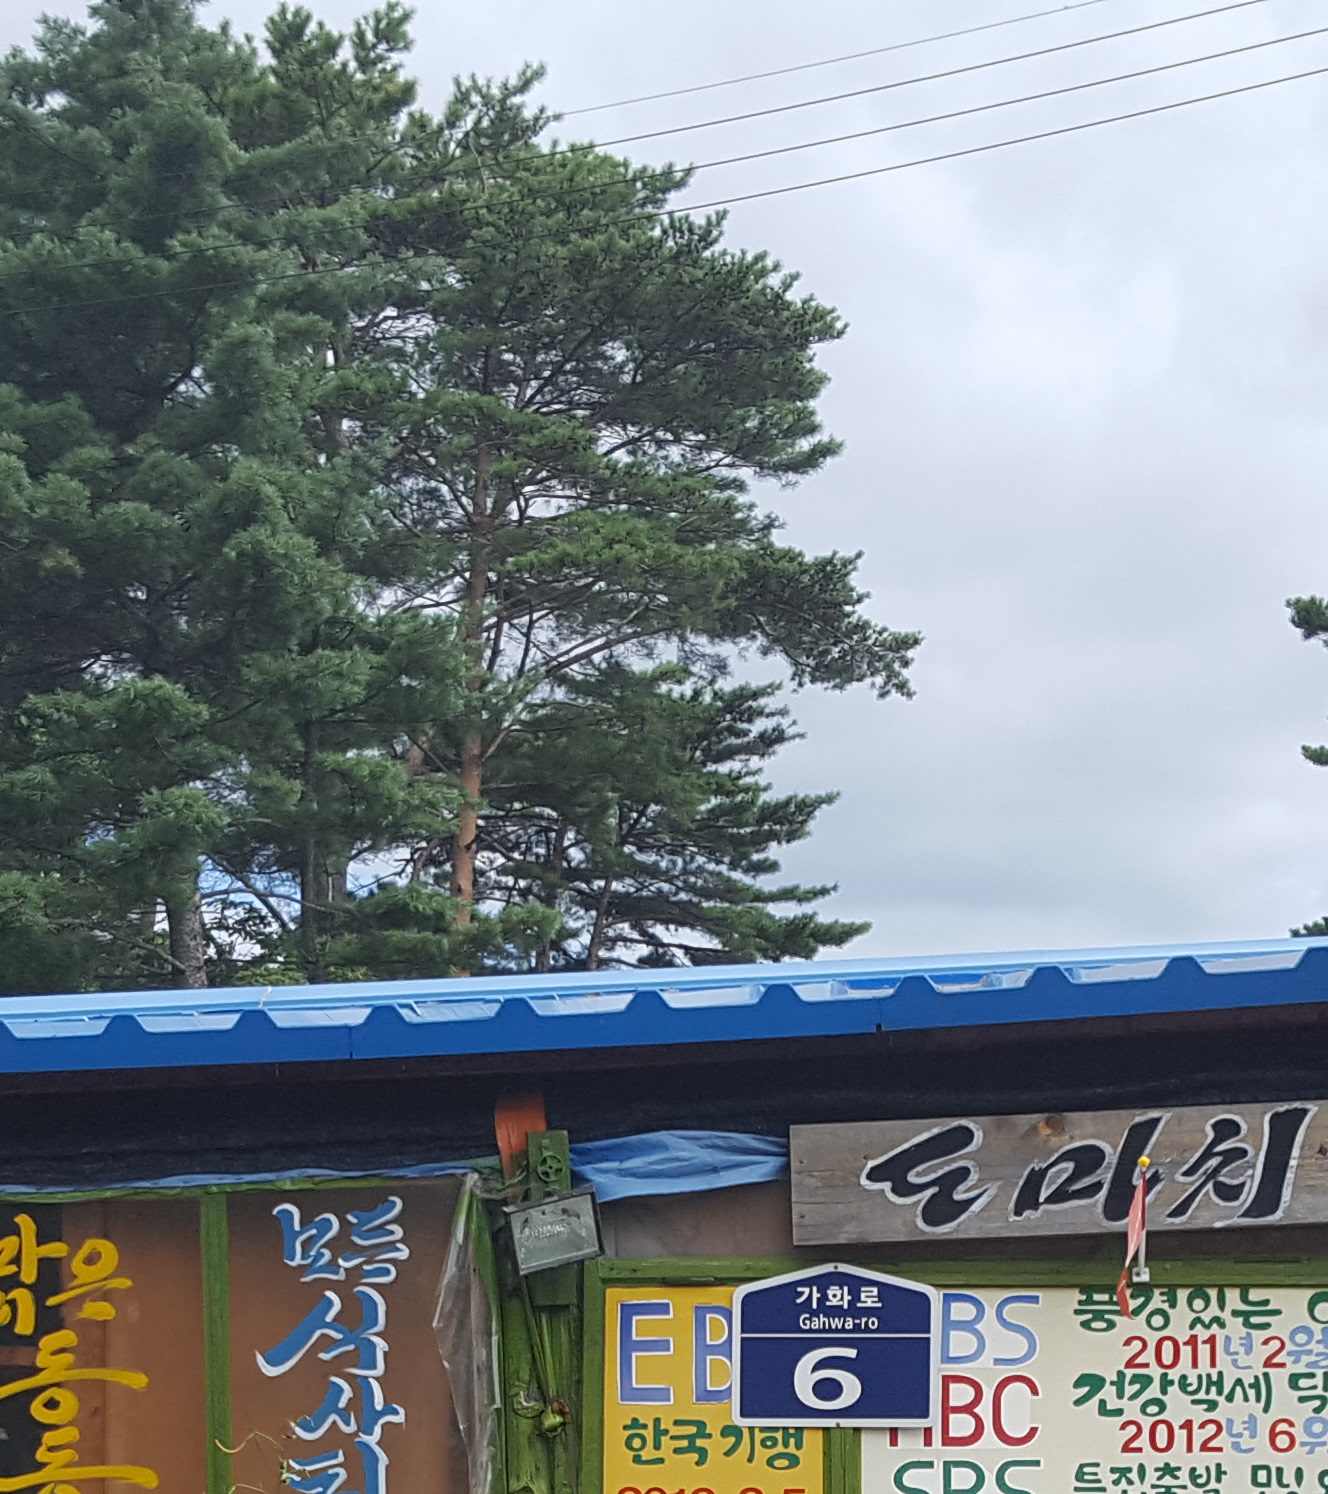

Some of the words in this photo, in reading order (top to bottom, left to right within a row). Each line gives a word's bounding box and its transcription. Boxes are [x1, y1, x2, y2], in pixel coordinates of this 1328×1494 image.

[795, 1285, 883, 1309] 가화로
[798, 1314, 879, 1332] Gahwa-ro
[940, 1293, 1042, 1367] BS
[1073, 1286, 1283, 1332] 풍경있는
[617, 1300, 732, 1404] EB
[793, 1347, 862, 1411] 6
[1072, 1370, 1273, 1417] 건강백세
[623, 1417, 805, 1470] 한국기행
[1119, 1413, 1258, 1454] 2012년
